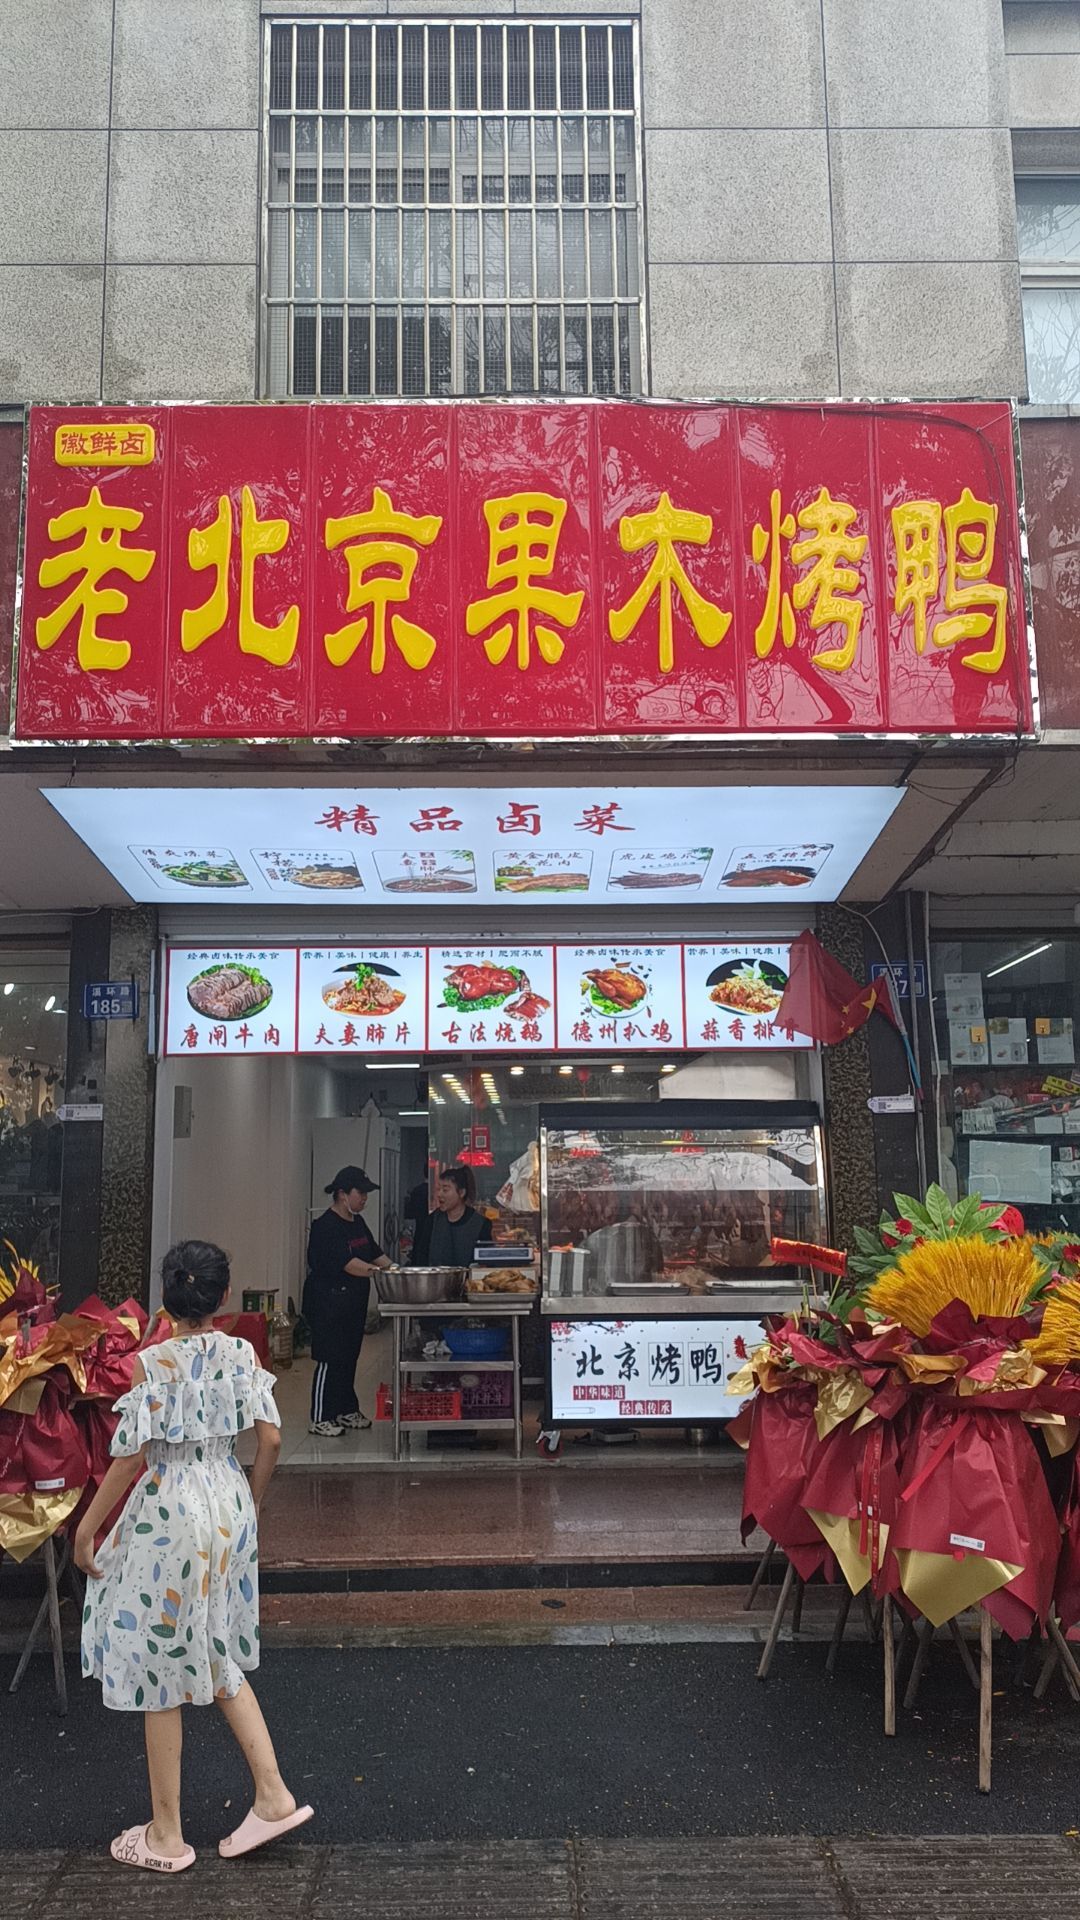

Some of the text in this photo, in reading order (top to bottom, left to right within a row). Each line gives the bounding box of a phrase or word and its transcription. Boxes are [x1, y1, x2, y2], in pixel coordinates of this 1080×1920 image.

[61, 431, 147, 458] 徽鲜卤
[35, 485, 1008, 675] 老北京果木烤鸭
[314, 803, 636, 836] 精品卤菜
[91, 999, 121, 1014] 185
[180, 1023, 281, 1048] 唐闸牛肉
[314, 1021, 411, 1046] 夫妻肺片
[441, 1020, 543, 1044] 古法烧鹅
[571, 1019, 673, 1043] 德州扒鸡
[576, 1341, 722, 1384] 北京烤鸭
[574, 1386, 625, 1400] 中华味道
[620, 1401, 672, 1414] 经典传承
